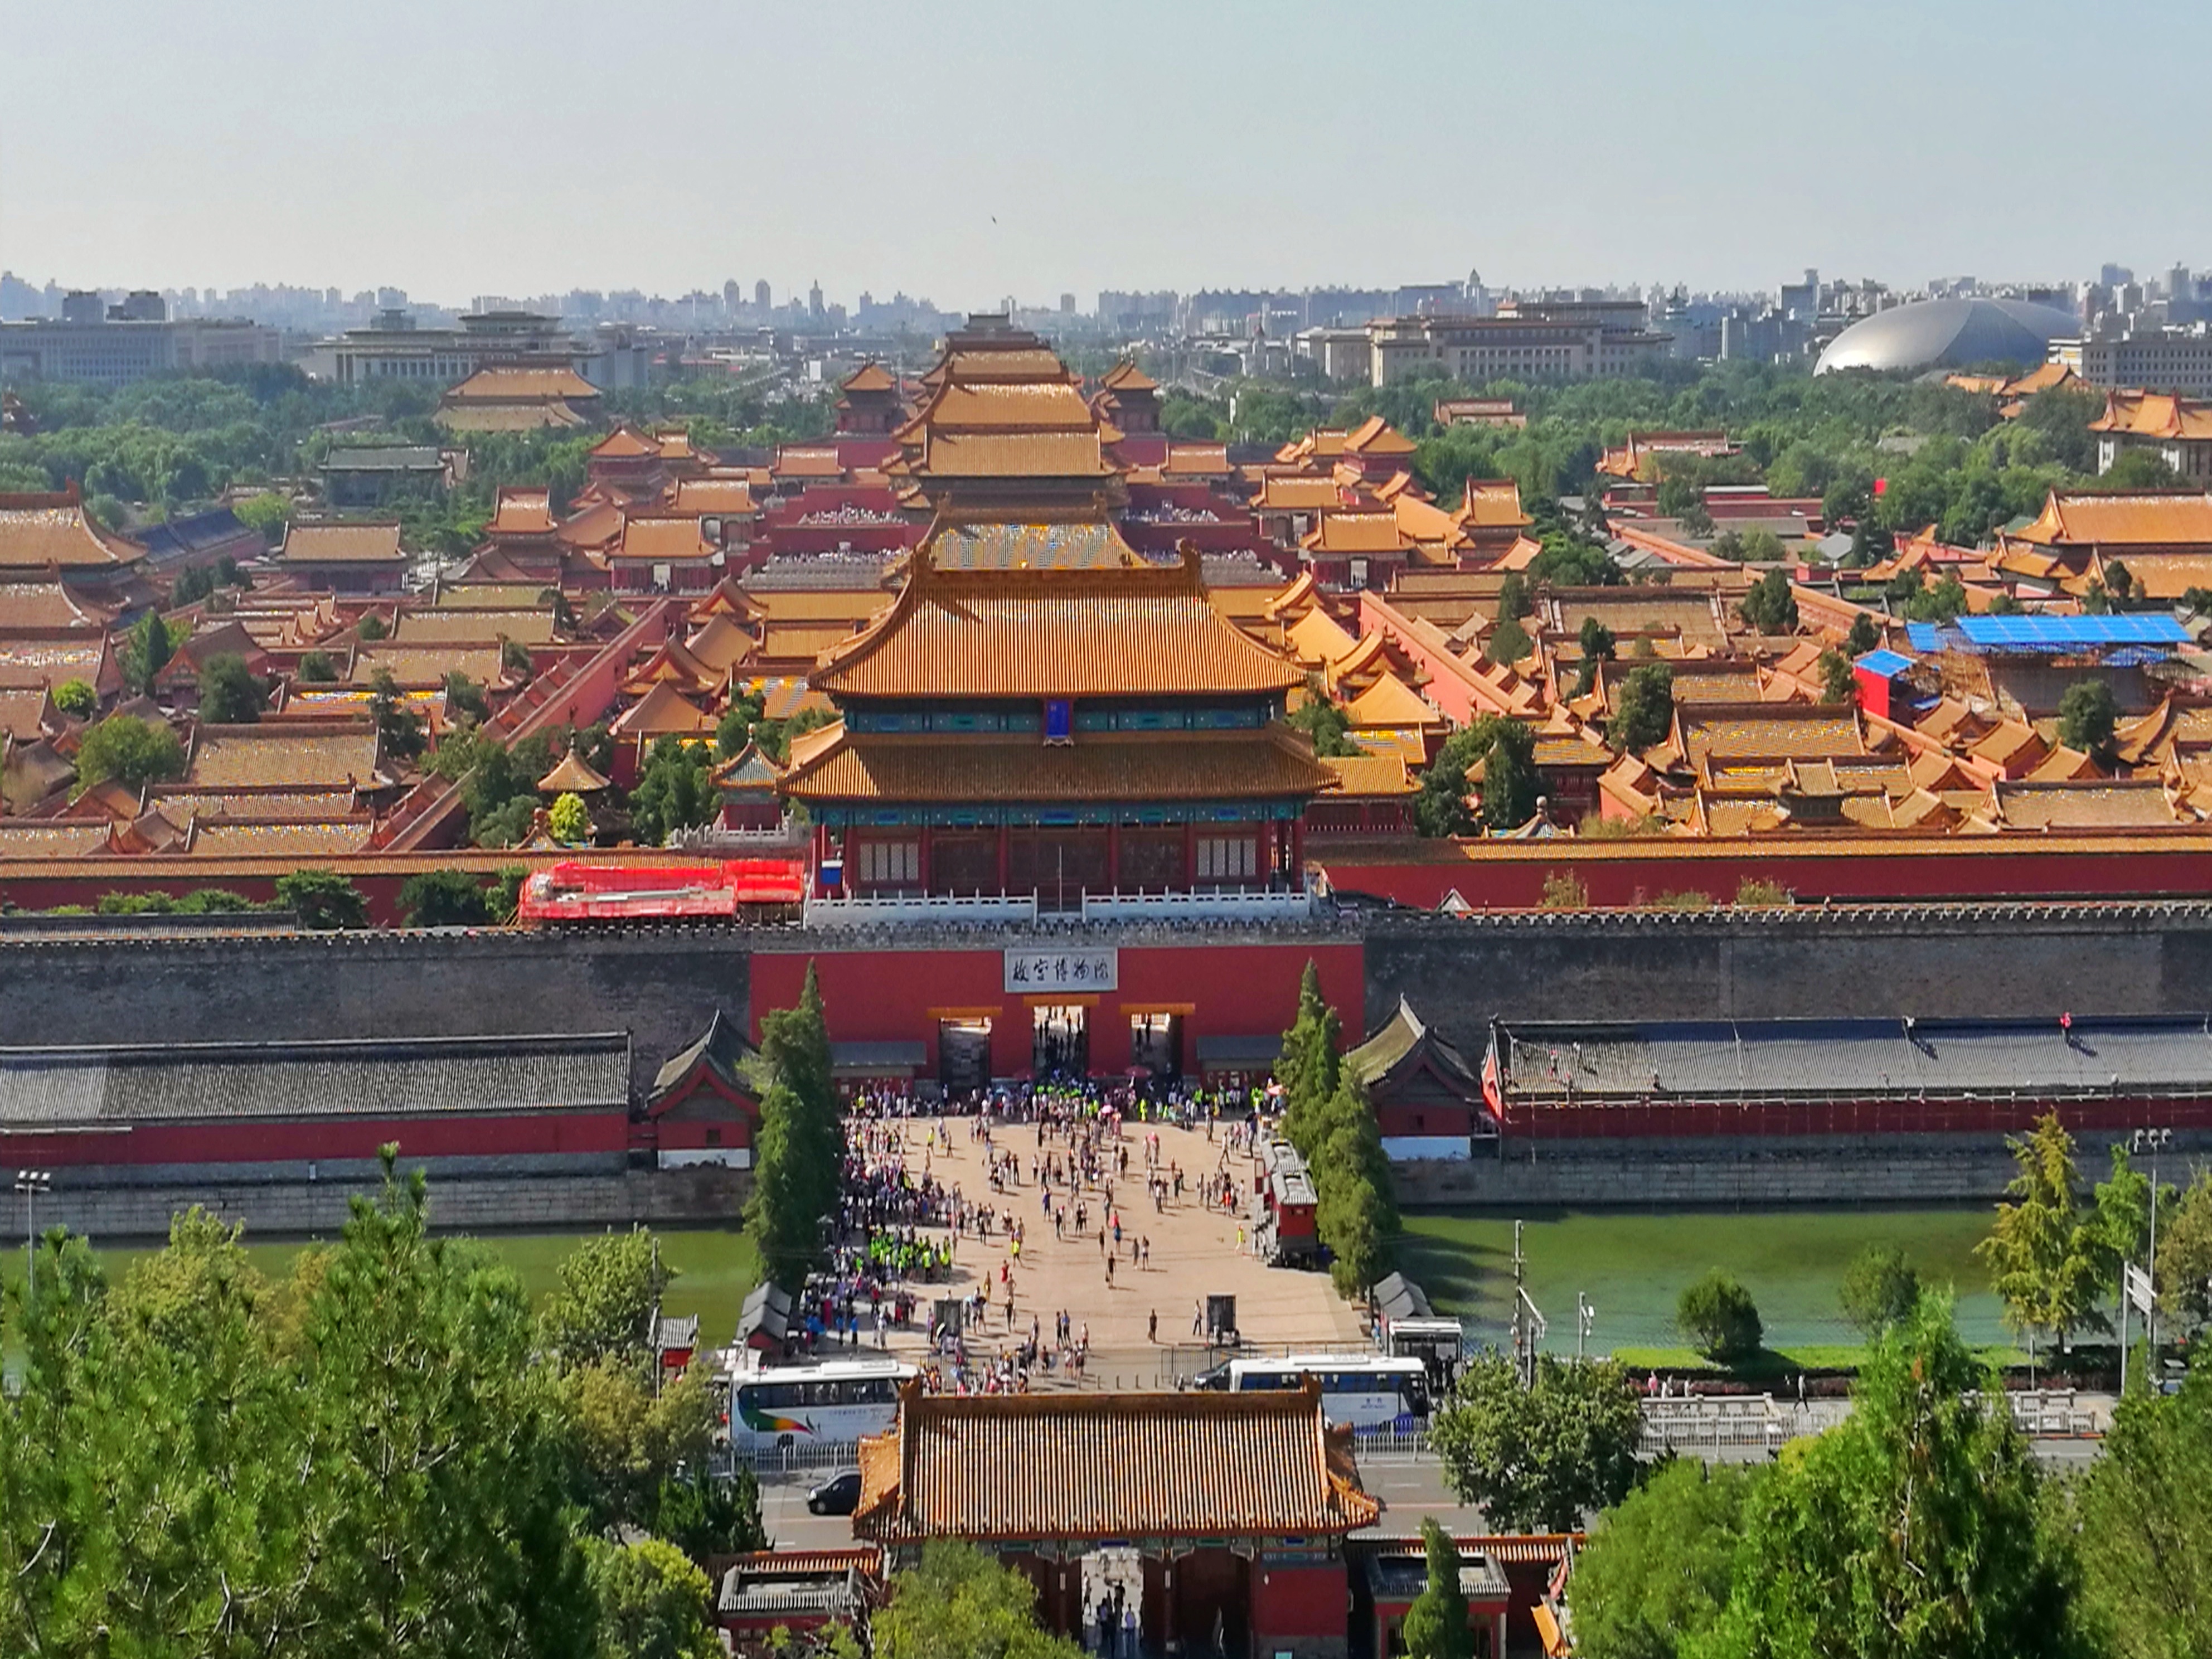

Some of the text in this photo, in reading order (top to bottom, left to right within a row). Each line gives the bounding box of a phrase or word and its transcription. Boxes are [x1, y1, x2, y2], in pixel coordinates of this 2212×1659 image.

[1012, 958, 1109, 982] 故宫博物院
